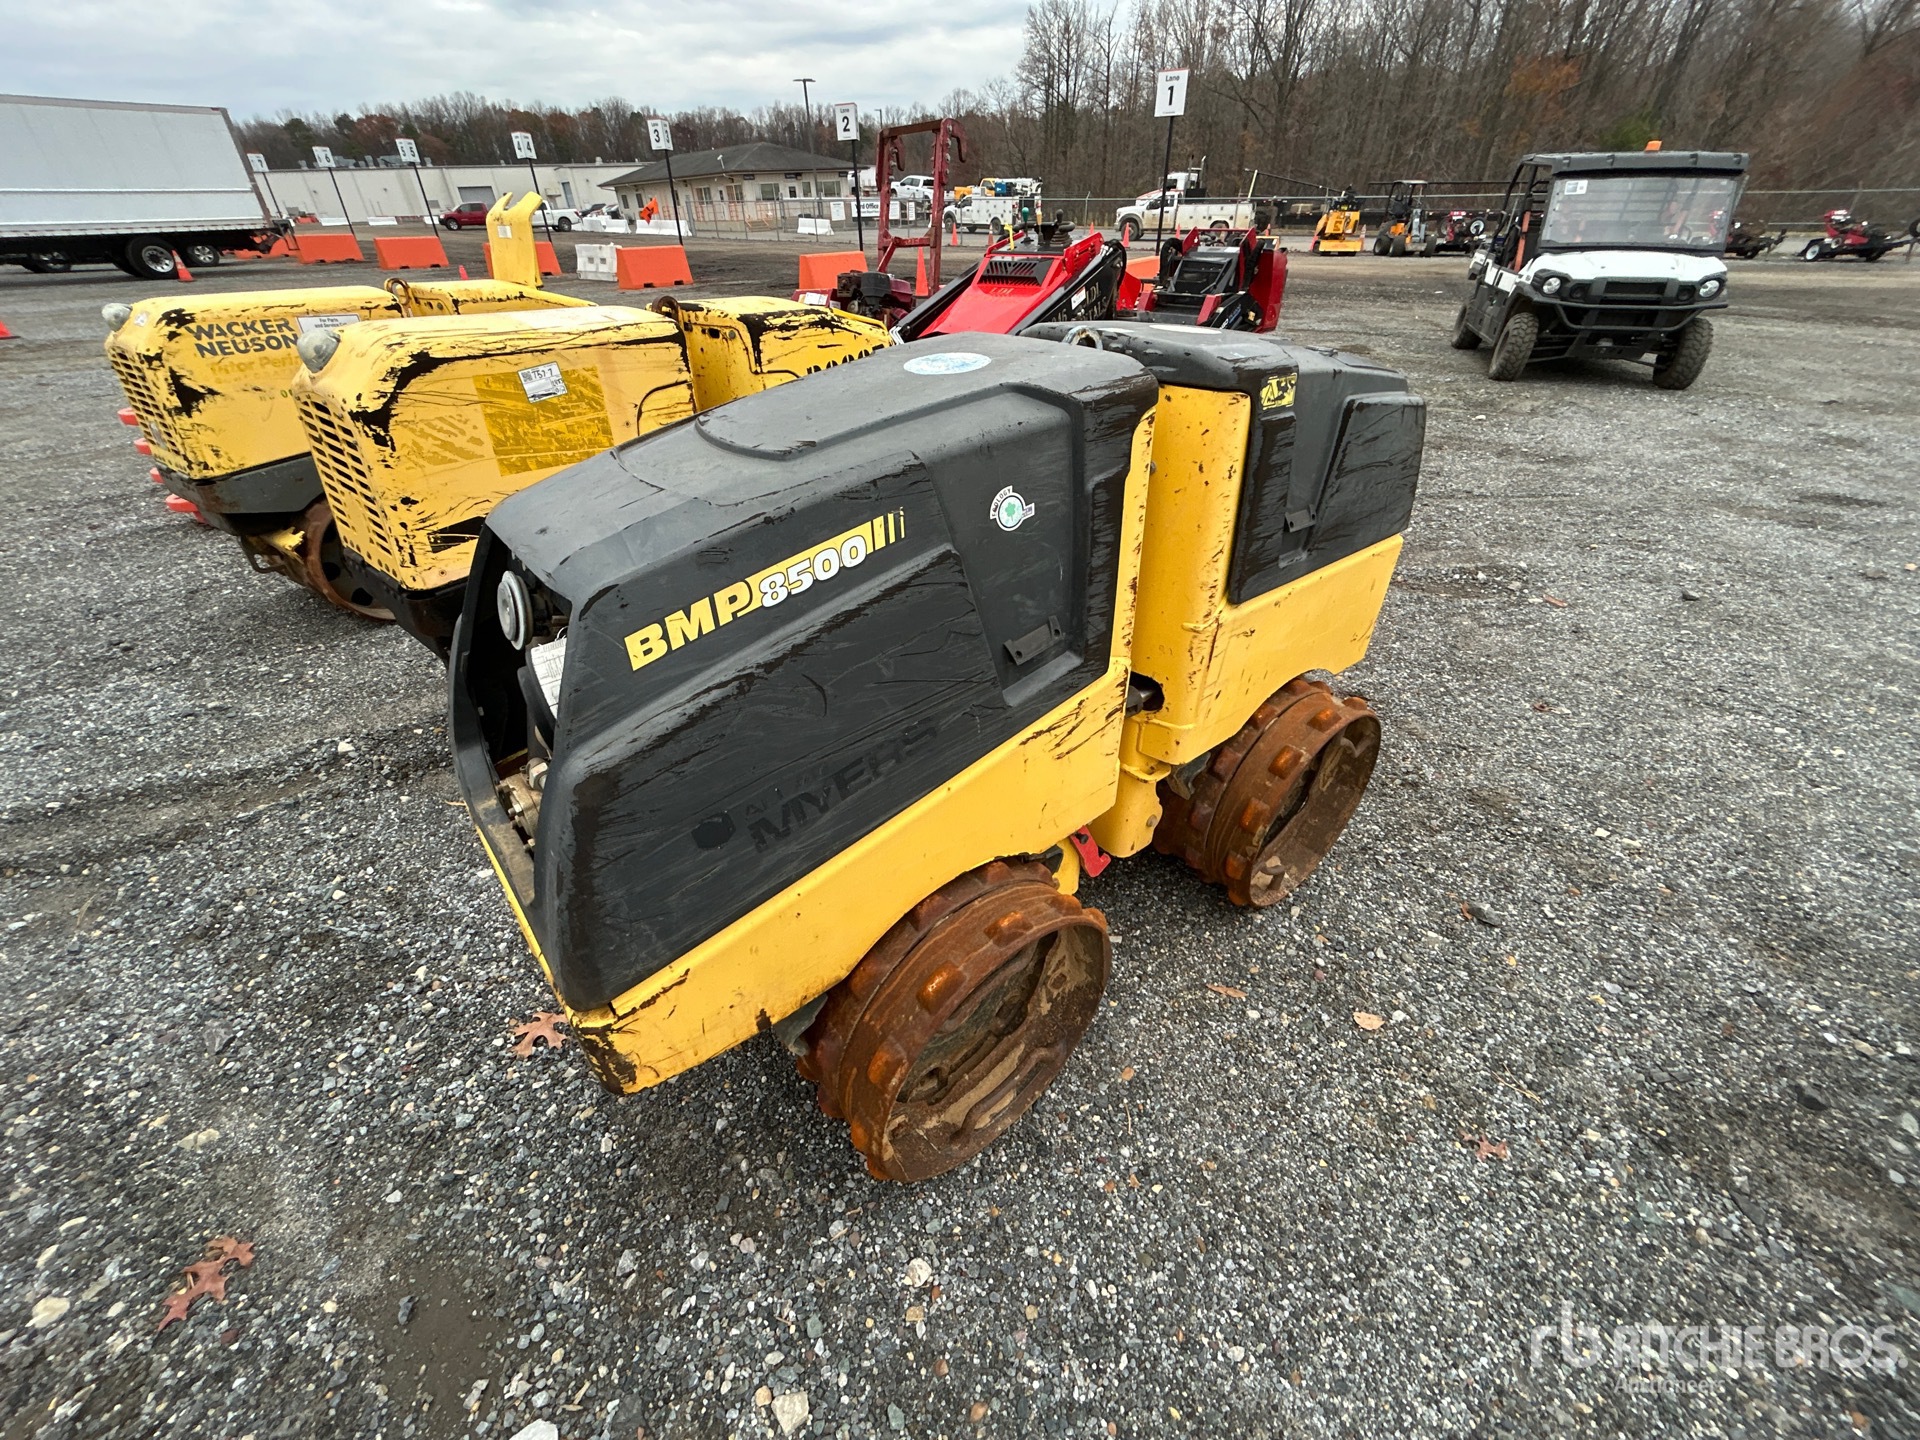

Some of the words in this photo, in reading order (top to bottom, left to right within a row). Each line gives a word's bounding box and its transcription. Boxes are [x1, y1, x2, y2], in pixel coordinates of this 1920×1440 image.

[1168, 85, 1175, 106] 1
[842, 115, 850, 132] 2
[653, 129, 660, 143] 3
[184, 317, 295, 341] WACKER
[194, 332, 299, 358] NEUSON
[992, 488, 1011, 517] EOLOGY
[624, 580, 752, 671] BMP
[759, 535, 867, 607] 8500
